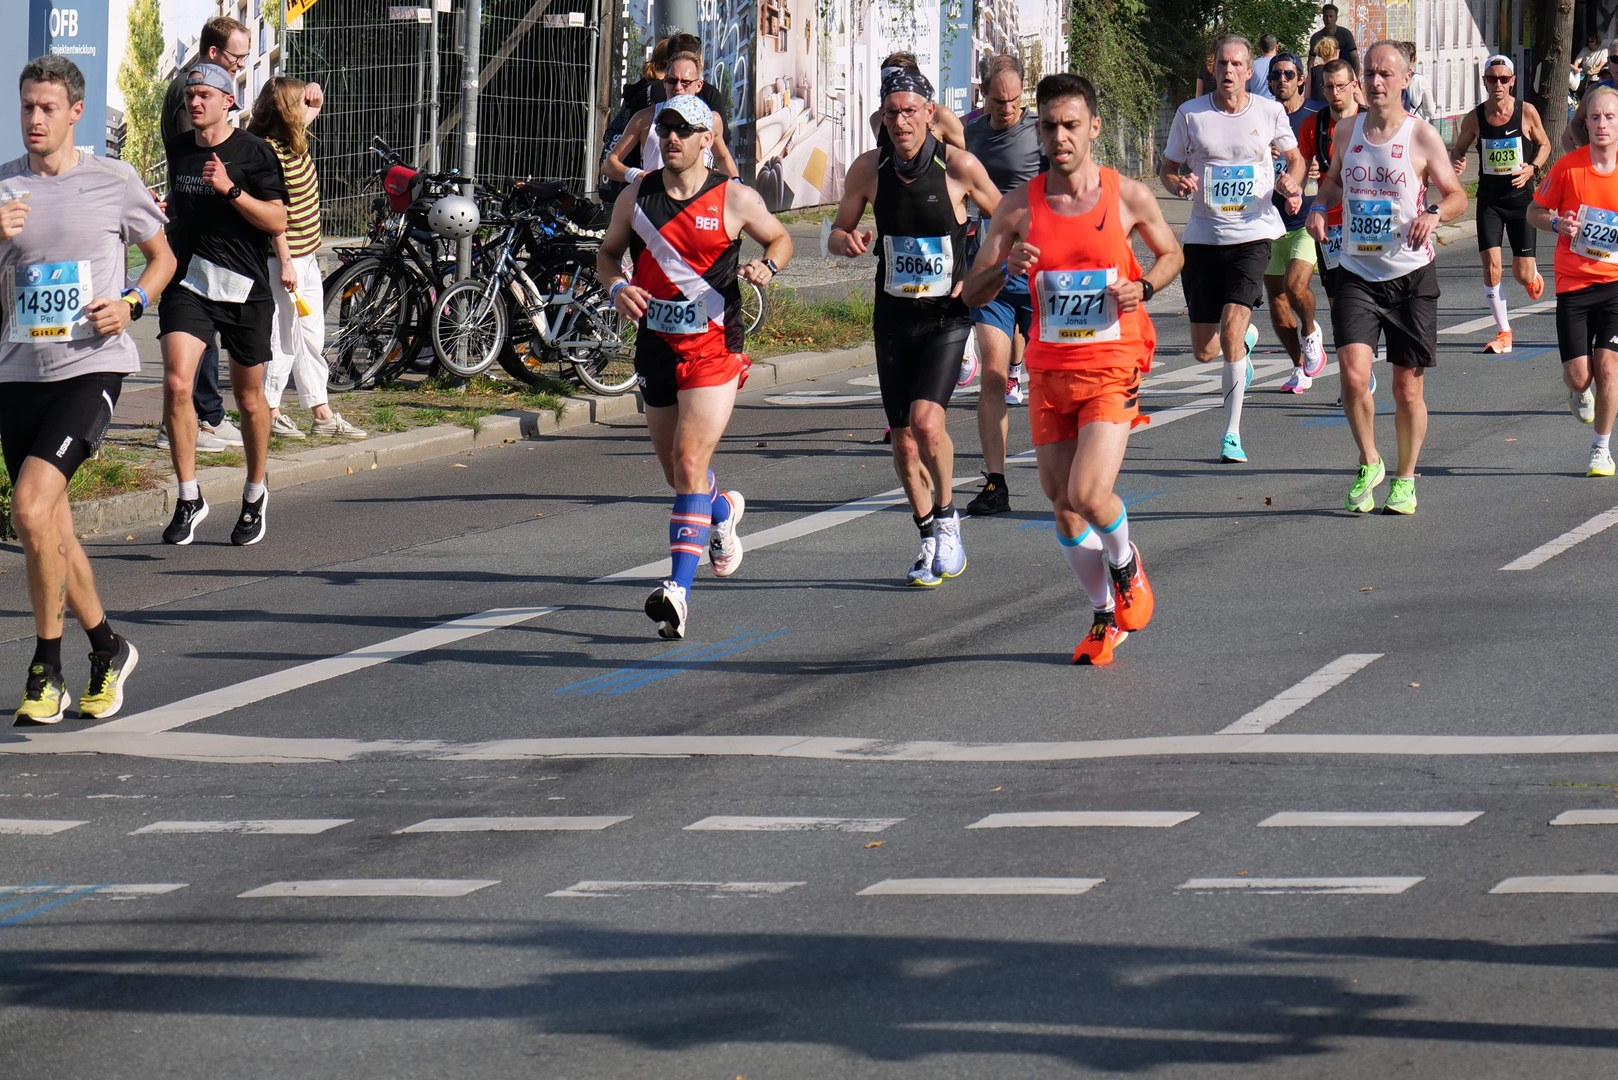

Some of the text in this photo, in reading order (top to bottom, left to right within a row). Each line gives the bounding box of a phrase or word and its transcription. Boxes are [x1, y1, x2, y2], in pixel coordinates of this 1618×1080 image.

[49, 8, 79, 38] OFB
[48, 43, 97, 57] Projektentwicklung
[618, 23, 630, 106] auer
[1489, 150, 1515, 163] 4033
[1275, 162, 1288, 175] 24
[175, 174, 211, 187] MIDNIG
[1345, 165, 1407, 189] POLSKA
[174, 183, 216, 196] RUNNERS
[1213, 181, 1254, 197] 16192
[1350, 186, 1399, 198] Running Team
[695, 216, 719, 231] BER
[1350, 216, 1391, 235] 53894
[895, 256, 943, 276] 56646
[18, 287, 80, 315] 14398
[1048, 293, 1106, 316] 17271
[40, 315, 54, 323] Per
[648, 301, 696, 324] 57295
[660, 323, 676, 333] Ryan
[1064, 317, 1088, 326] Jonas
[31, 328, 54, 337] Giti
[1061, 330, 1082, 338] Giti
